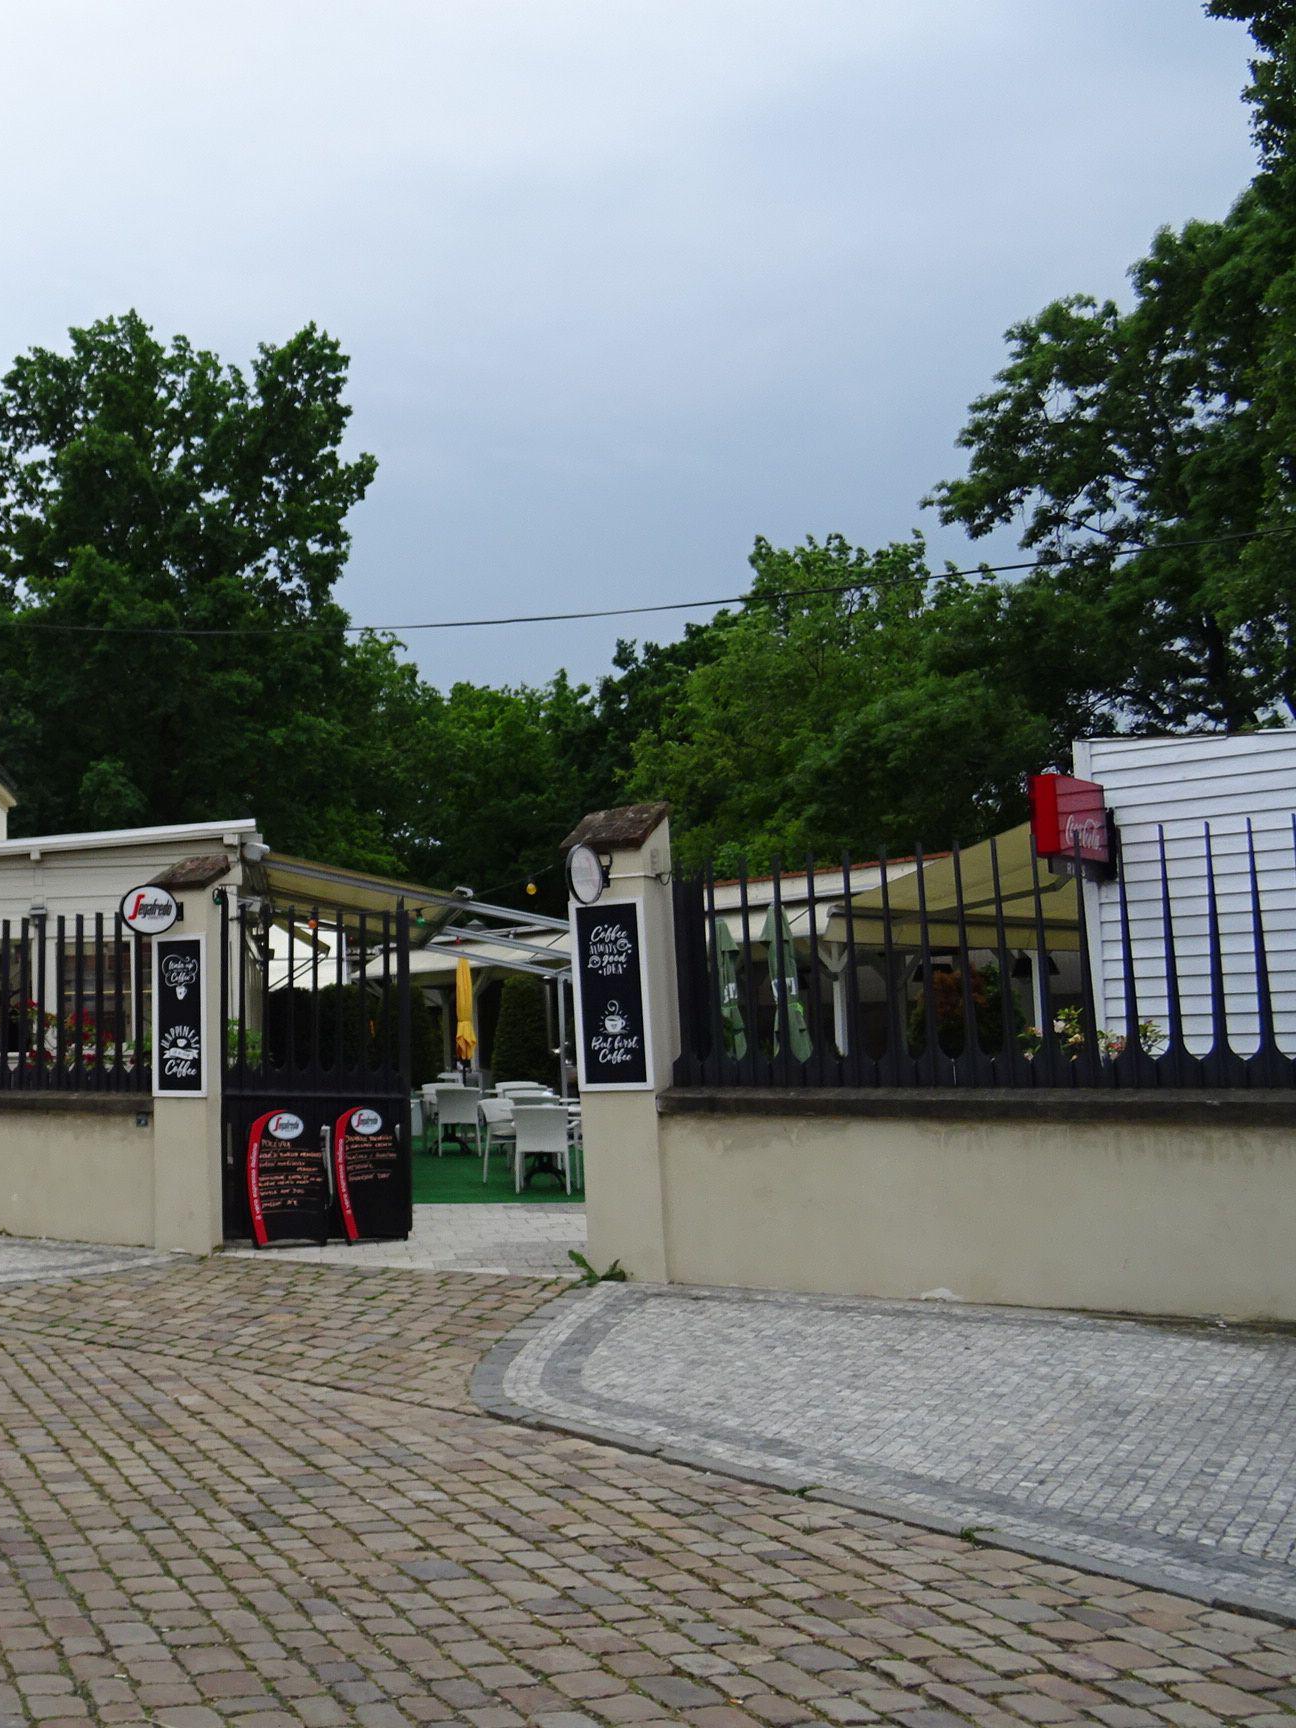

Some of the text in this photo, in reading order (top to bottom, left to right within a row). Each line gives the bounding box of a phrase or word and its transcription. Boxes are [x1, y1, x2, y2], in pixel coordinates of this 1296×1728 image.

[128, 894, 173, 920] Segafredo
[590, 924, 628, 942] Coffee
[602, 952, 627, 967] good
[160, 1024, 200, 1049] HAPPINESS
[591, 1036, 613, 1050] But
[598, 1048, 632, 1065] Coffee
[164, 1059, 197, 1078] Coffee
